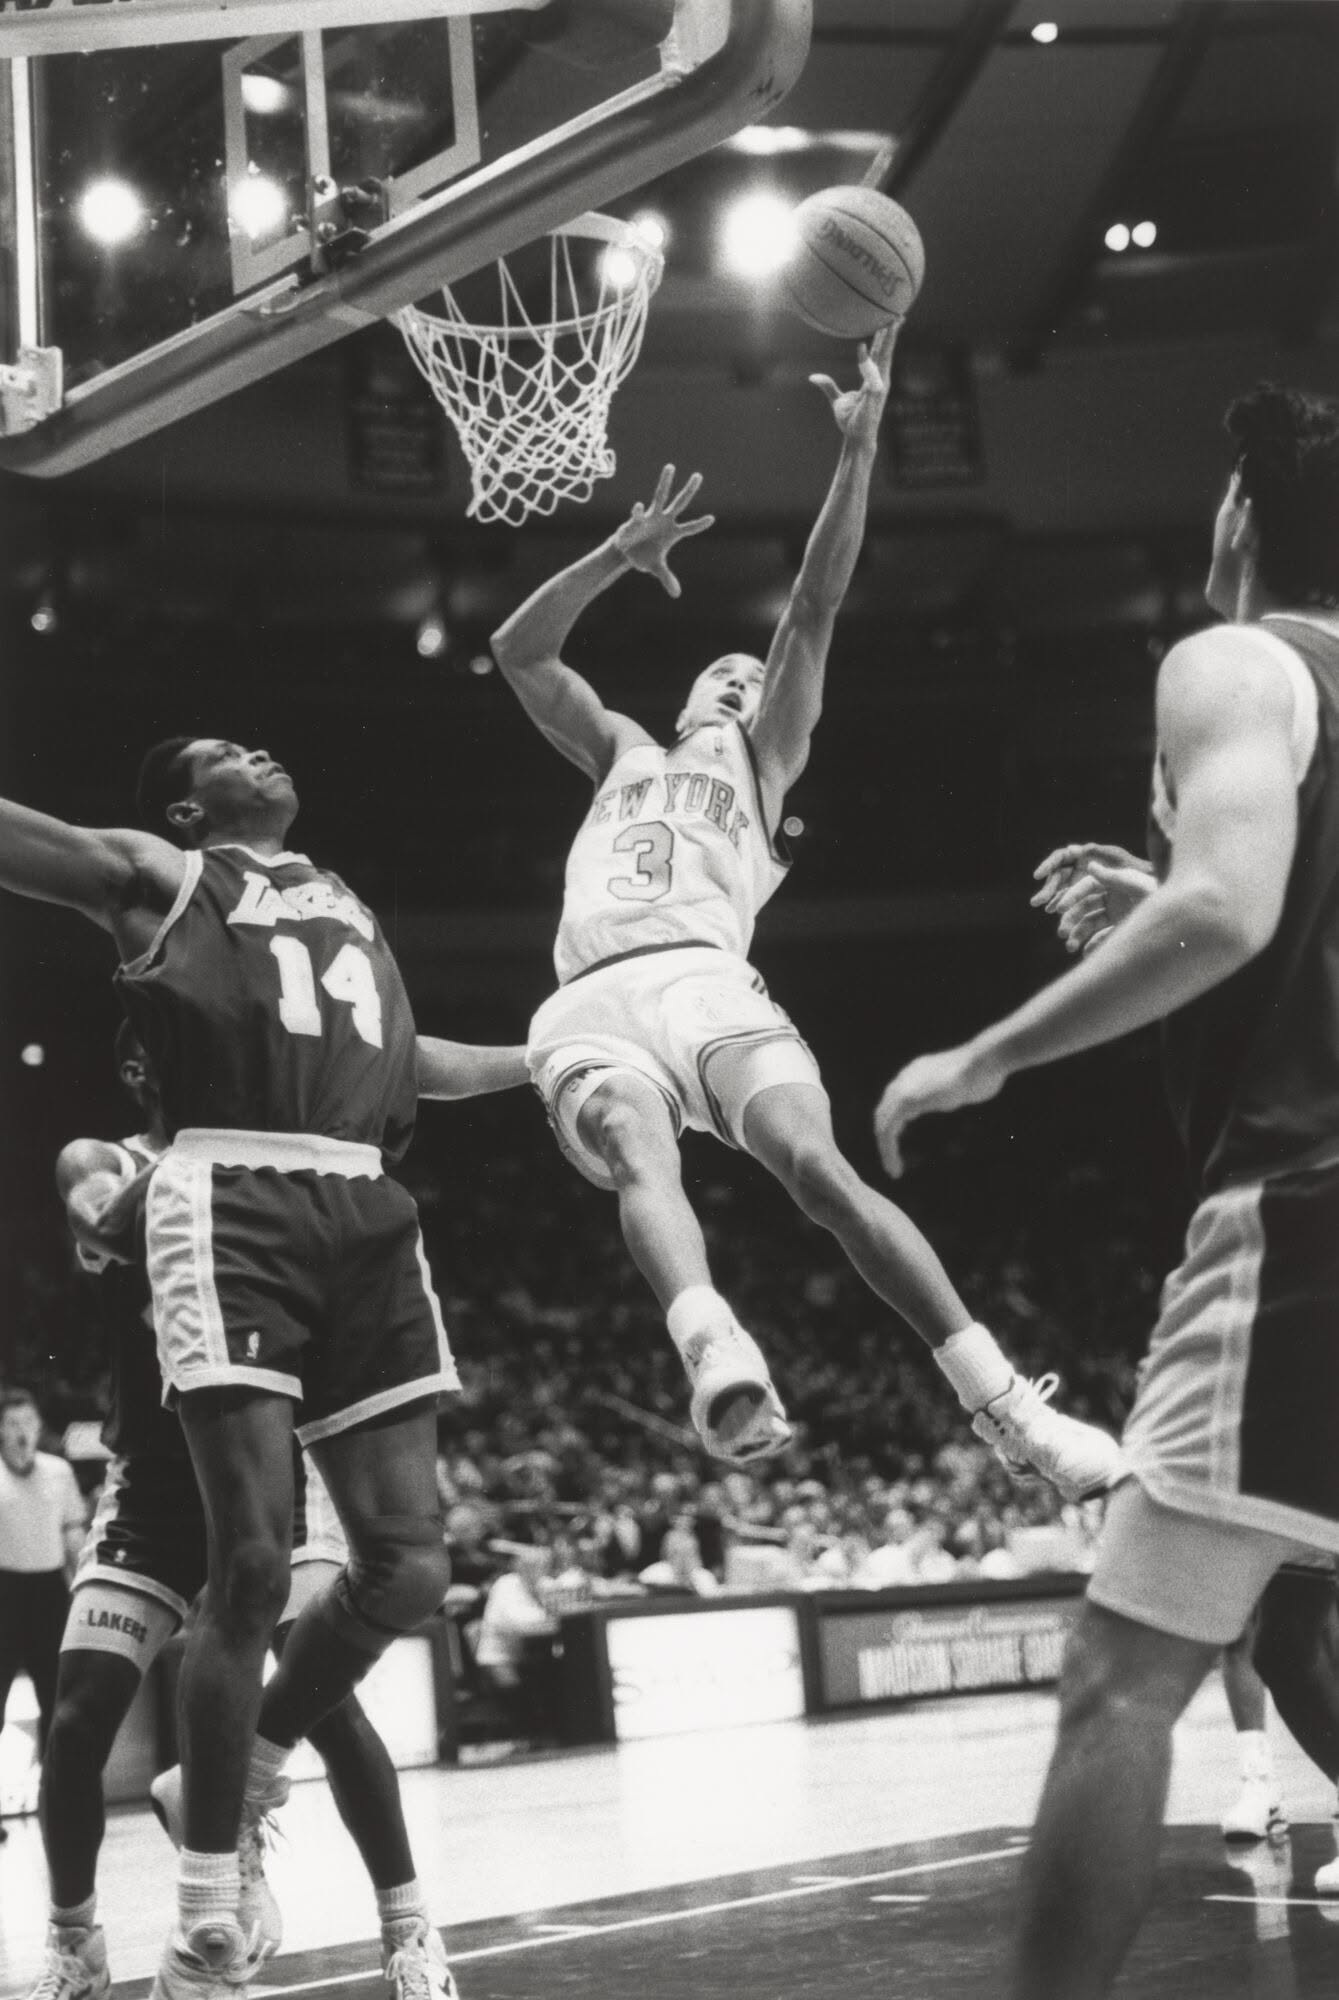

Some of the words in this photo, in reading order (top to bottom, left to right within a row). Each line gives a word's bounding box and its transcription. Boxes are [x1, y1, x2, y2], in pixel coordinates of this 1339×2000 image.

[817, 218, 906, 297] SPALDING
[590, 778, 654, 824] EW
[664, 772, 750, 849] YORK
[607, 820, 675, 903] 3
[269, 934, 384, 1050] 14
[87, 1608, 147, 1643] LAKERS
